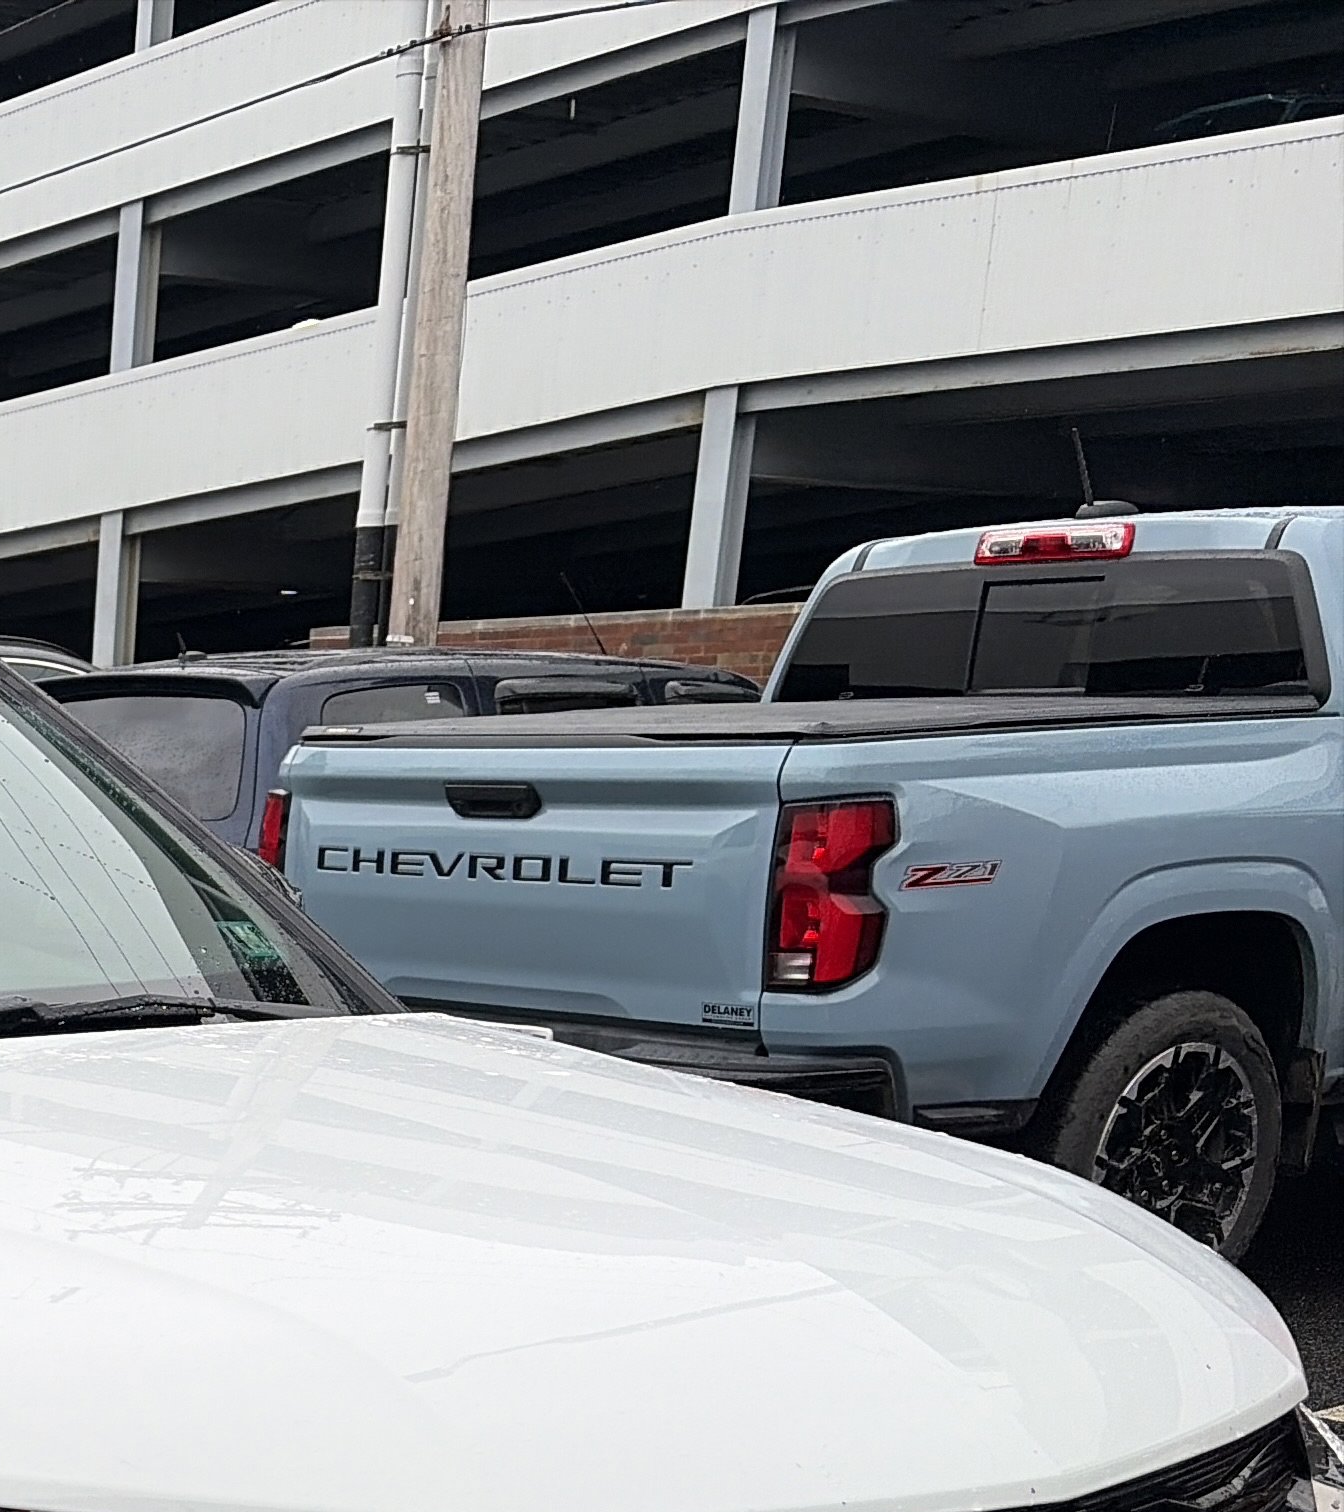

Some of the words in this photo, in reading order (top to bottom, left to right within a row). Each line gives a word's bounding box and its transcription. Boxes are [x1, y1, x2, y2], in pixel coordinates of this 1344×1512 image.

[317, 843, 694, 890] CHEVROLET
[899, 859, 1002, 891] Z71
[703, 1004, 752, 1017] DELANEY
